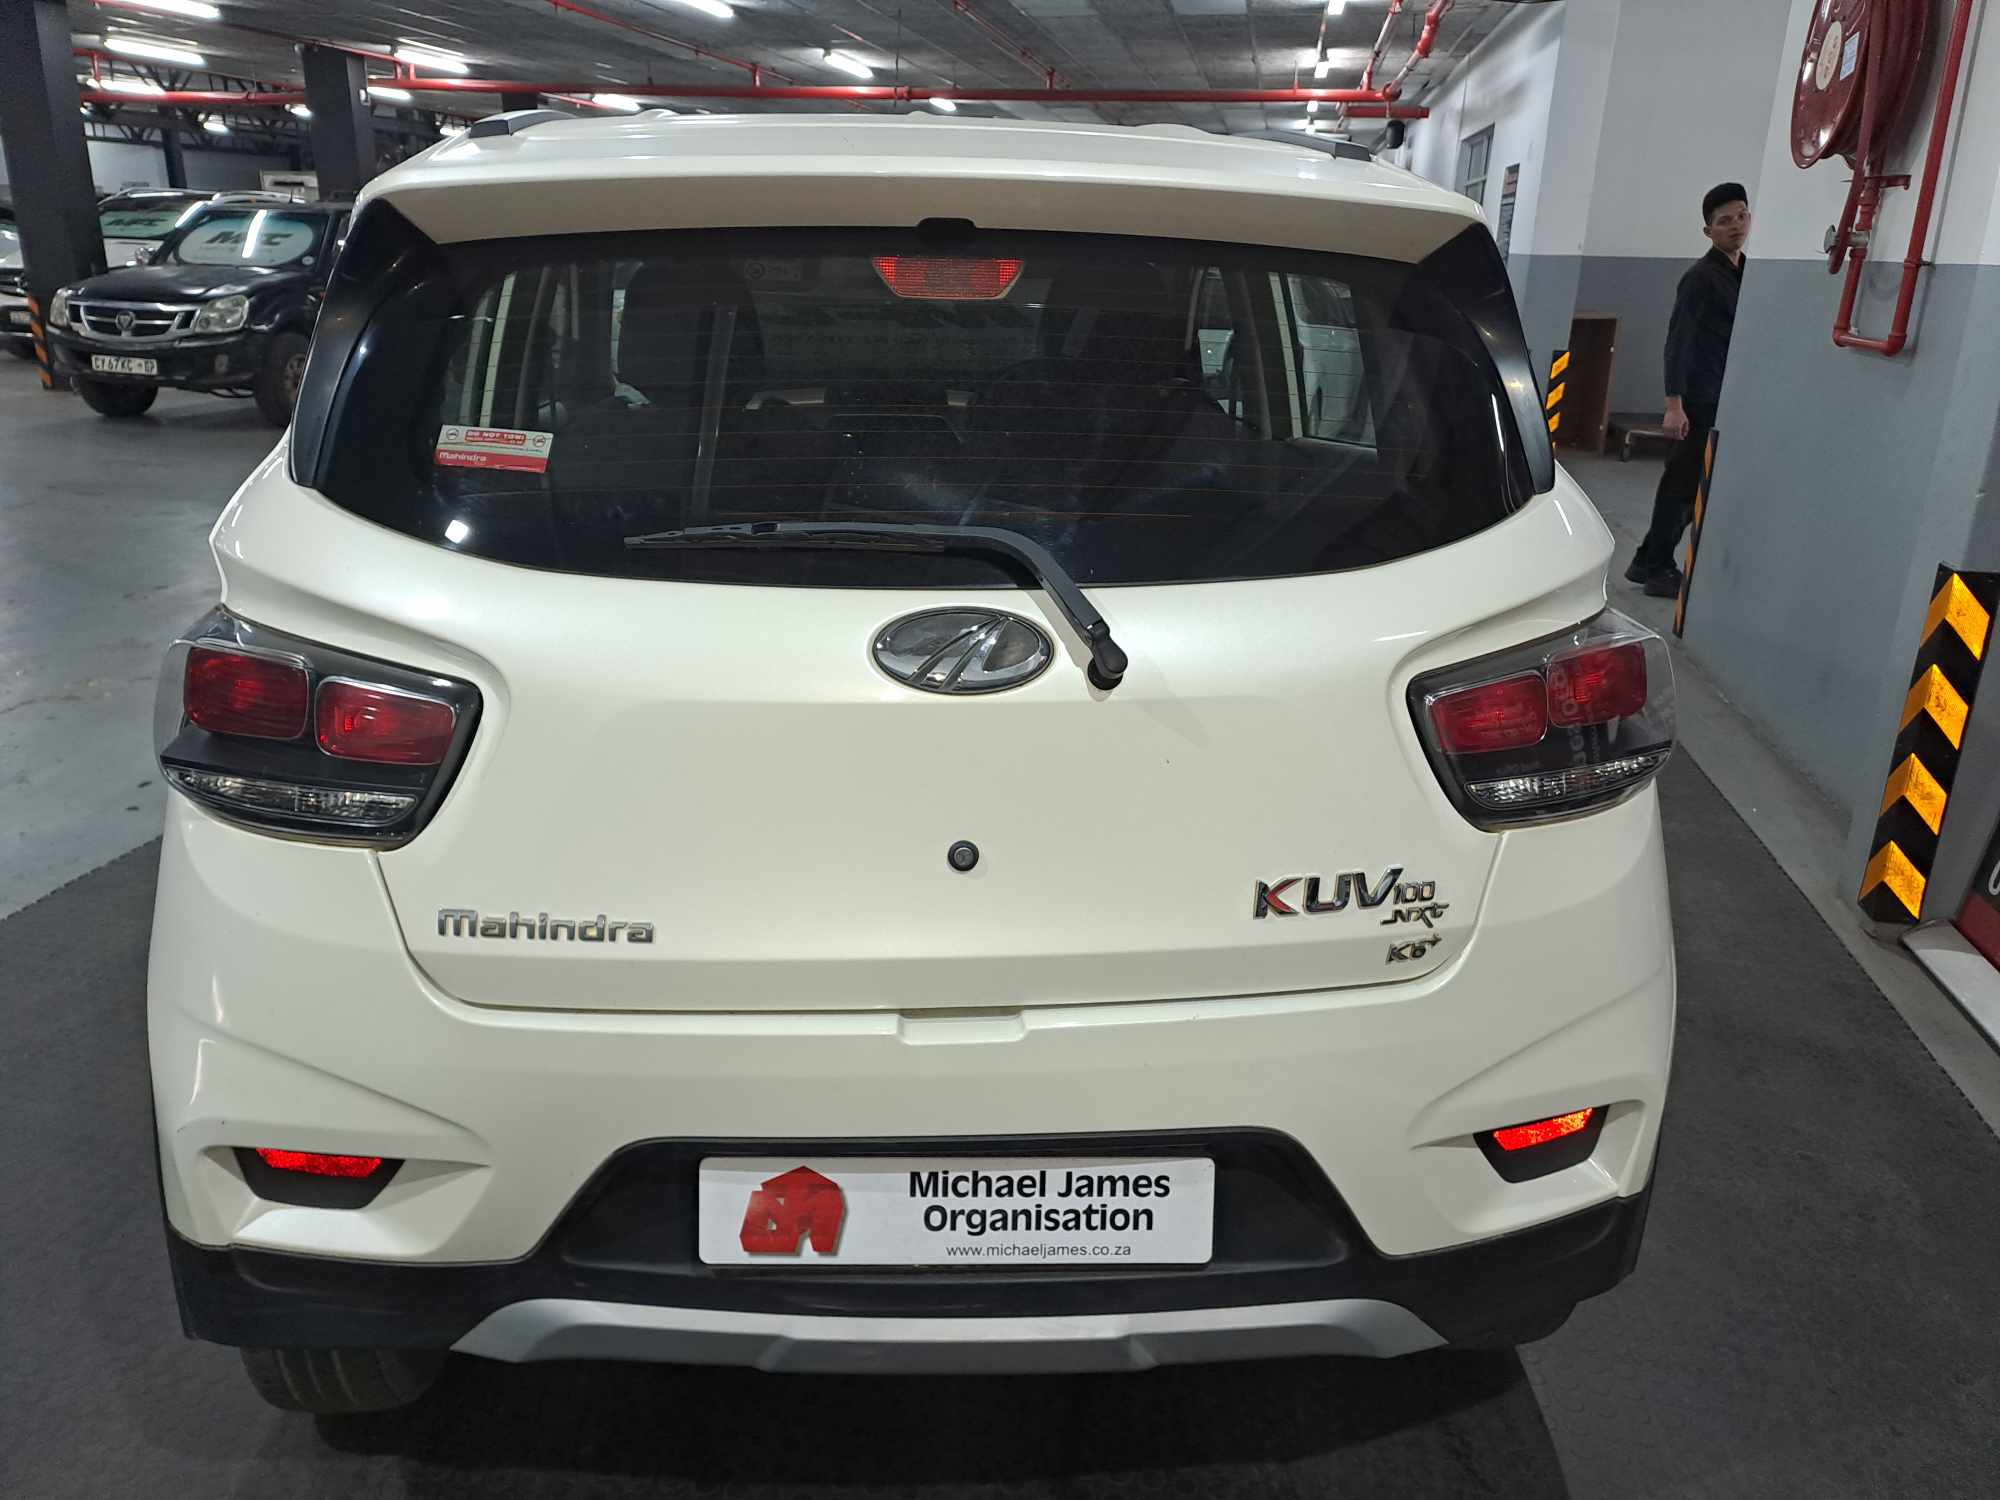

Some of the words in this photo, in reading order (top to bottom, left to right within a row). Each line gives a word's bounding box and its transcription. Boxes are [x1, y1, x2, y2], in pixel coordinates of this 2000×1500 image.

[439, 451, 487, 462] Mahindra
[438, 908, 654, 943] Mahindra
[909, 1170, 1047, 1198] Michael
[1057, 1170, 1171, 1198] James
[923, 1203, 1154, 1236] Organisation
[945, 1243, 1132, 1259] www.michaeljames.co.za
